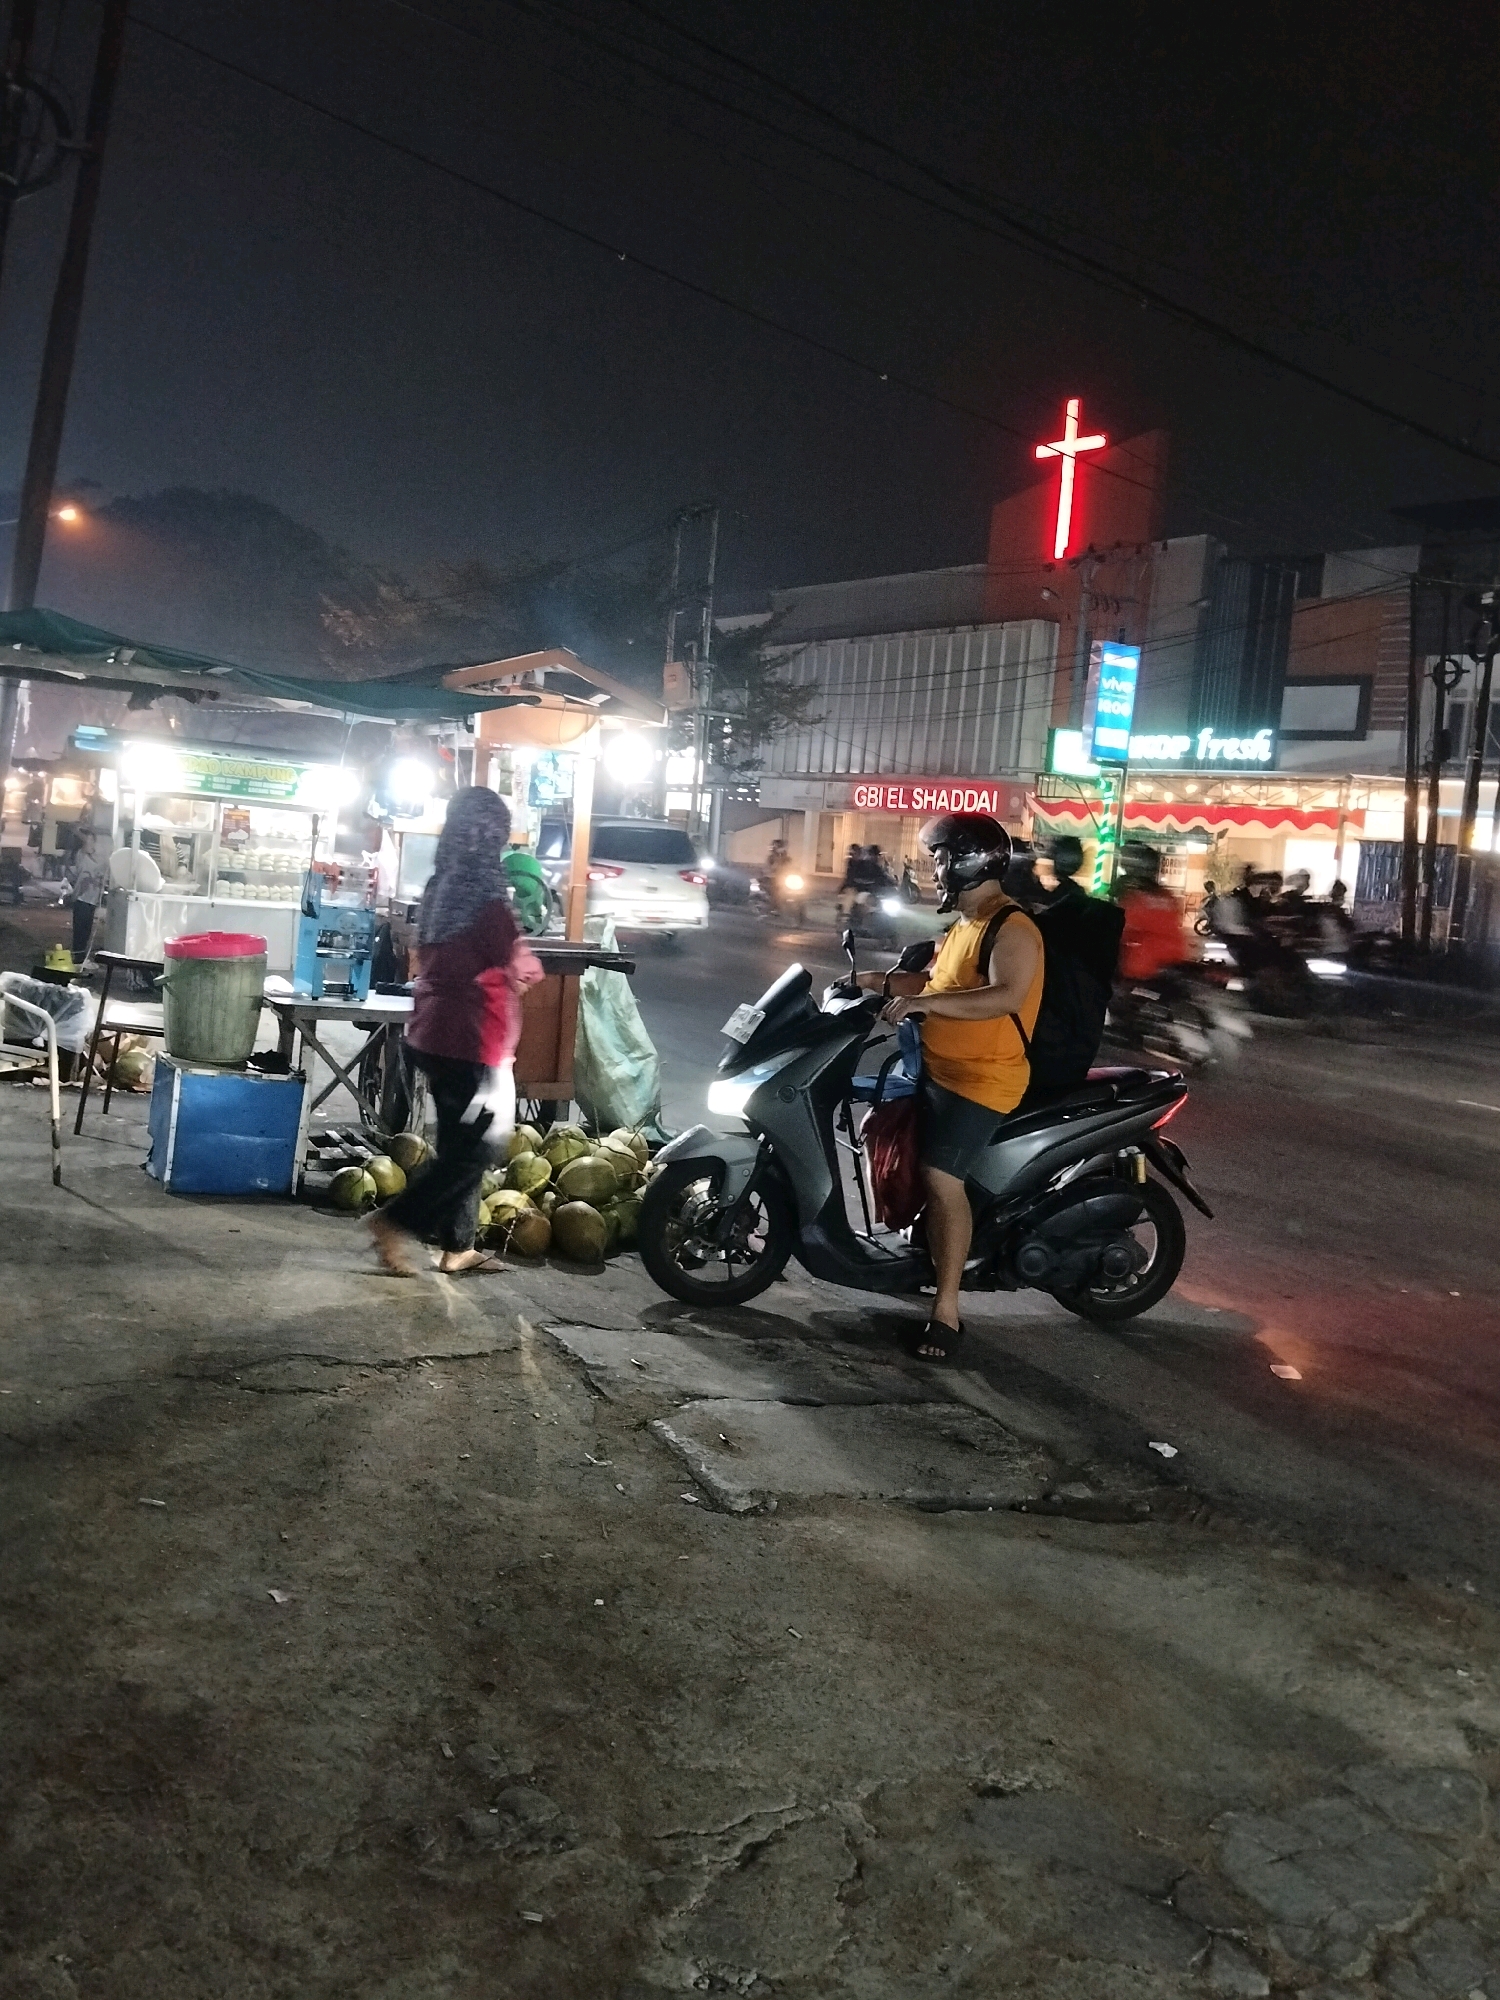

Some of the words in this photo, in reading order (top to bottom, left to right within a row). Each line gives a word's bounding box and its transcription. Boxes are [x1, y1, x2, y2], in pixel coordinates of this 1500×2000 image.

[1101, 676, 1133, 693] vivo
[1197, 728, 1272, 761] fresh
[222, 760, 296, 783] KAMPUNG
[854, 785, 883, 807] GBI
[887, 787, 909, 809] EL
[912, 787, 998, 812] SHADDAI
